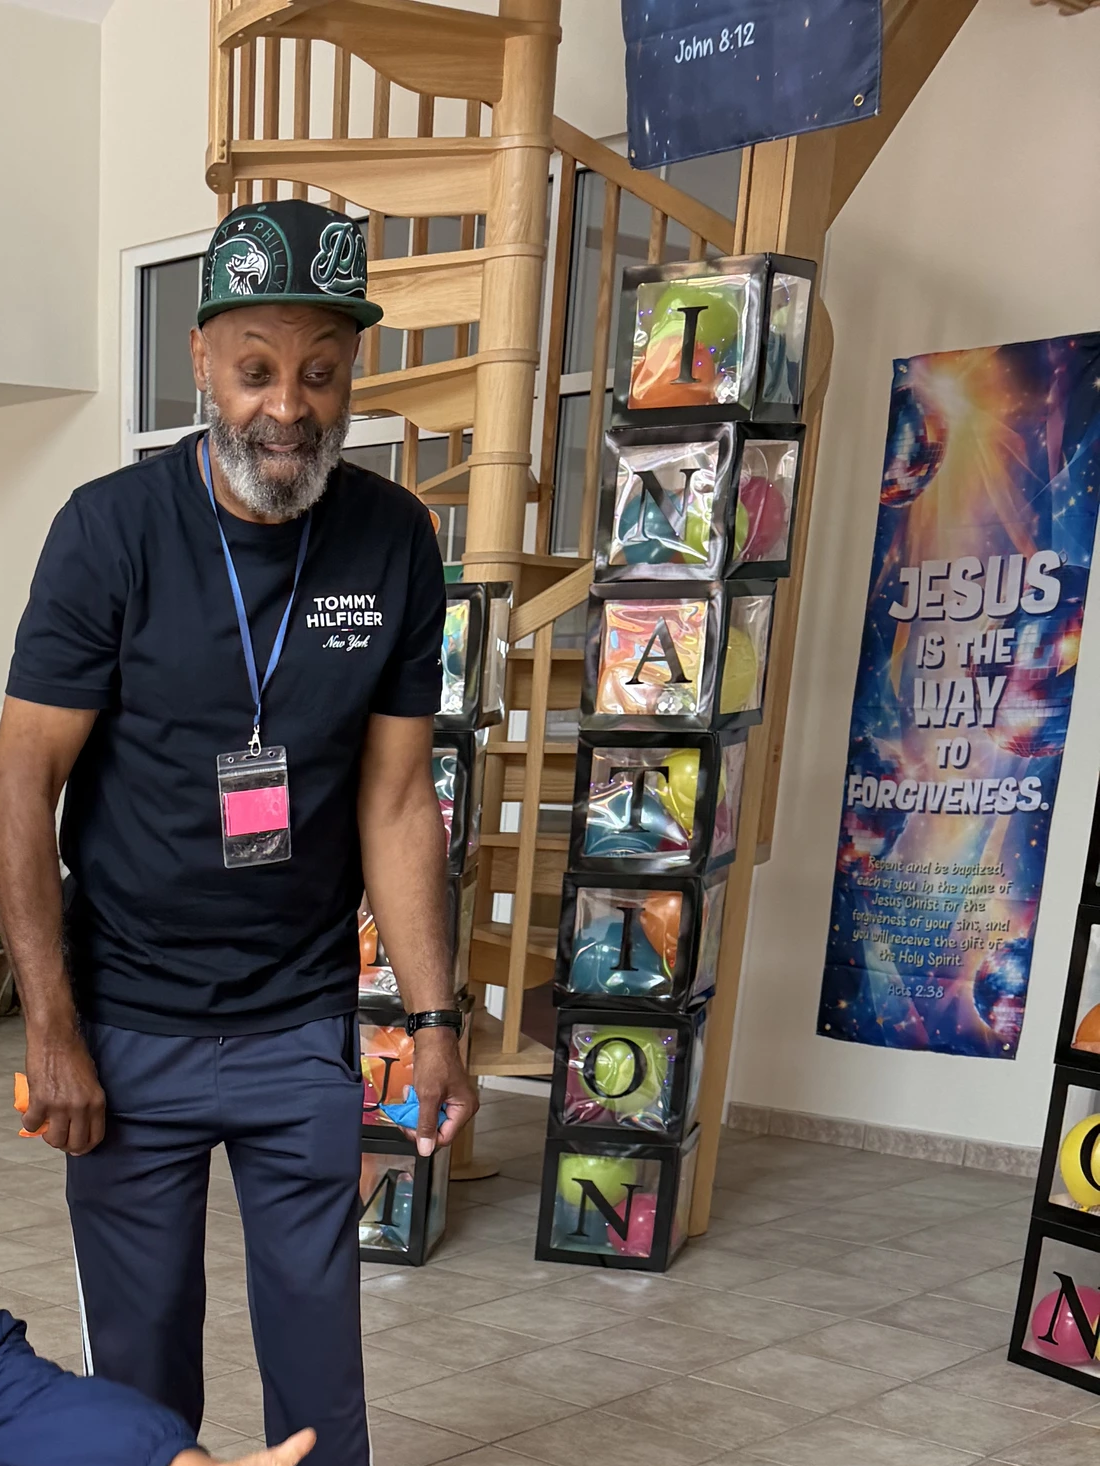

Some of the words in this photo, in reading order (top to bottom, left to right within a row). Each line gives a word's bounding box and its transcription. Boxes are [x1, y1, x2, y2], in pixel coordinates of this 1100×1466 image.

[674, 35, 714, 64] John
[718, 22, 755, 52] 8:12
[888, 550, 1061, 622] JESUS
[313, 594, 376, 611] TOMMY
[306, 611, 383, 628] HILFIGER
[322, 634, 345, 649] New
[346, 634, 371, 652] York
[916, 631, 945, 669] IS
[957, 628, 1015, 667] THE
[913, 676, 1008, 728] WAY
[936, 737, 971, 769] TO
[847, 774, 1050, 815] FORGIVENESS.
[906, 862, 932, 875] and
[934, 862, 949, 875] be
[952, 862, 1005, 878] baptized,
[857, 875, 881, 888] each
[882, 876, 894, 887] of
[895, 880, 917, 892] you
[938, 880, 957, 893] the
[961, 884, 995, 894] name
[999, 880, 1013, 894] of
[871, 893, 901, 906] Jesus
[904, 896, 939, 911] Christ
[963, 899, 986, 912] the
[852, 909, 906, 927] forgiveness
[909, 916, 925, 928] of
[925, 919, 951, 932] your
[956, 919, 981, 933] sins,
[985, 920, 1010, 932] and
[852, 931, 869, 942] you
[871, 930, 889, 944] will
[890, 935, 930, 947] receive
[934, 936, 957, 948] the
[960, 937, 984, 951] gift
[988, 938, 1003, 949] of
[879, 949, 895, 963] the
[899, 951, 924, 967] Holy
[927, 952, 964, 967] Spirit.
[888, 985, 911, 996] Acts
[915, 985, 944, 998] 2:38
